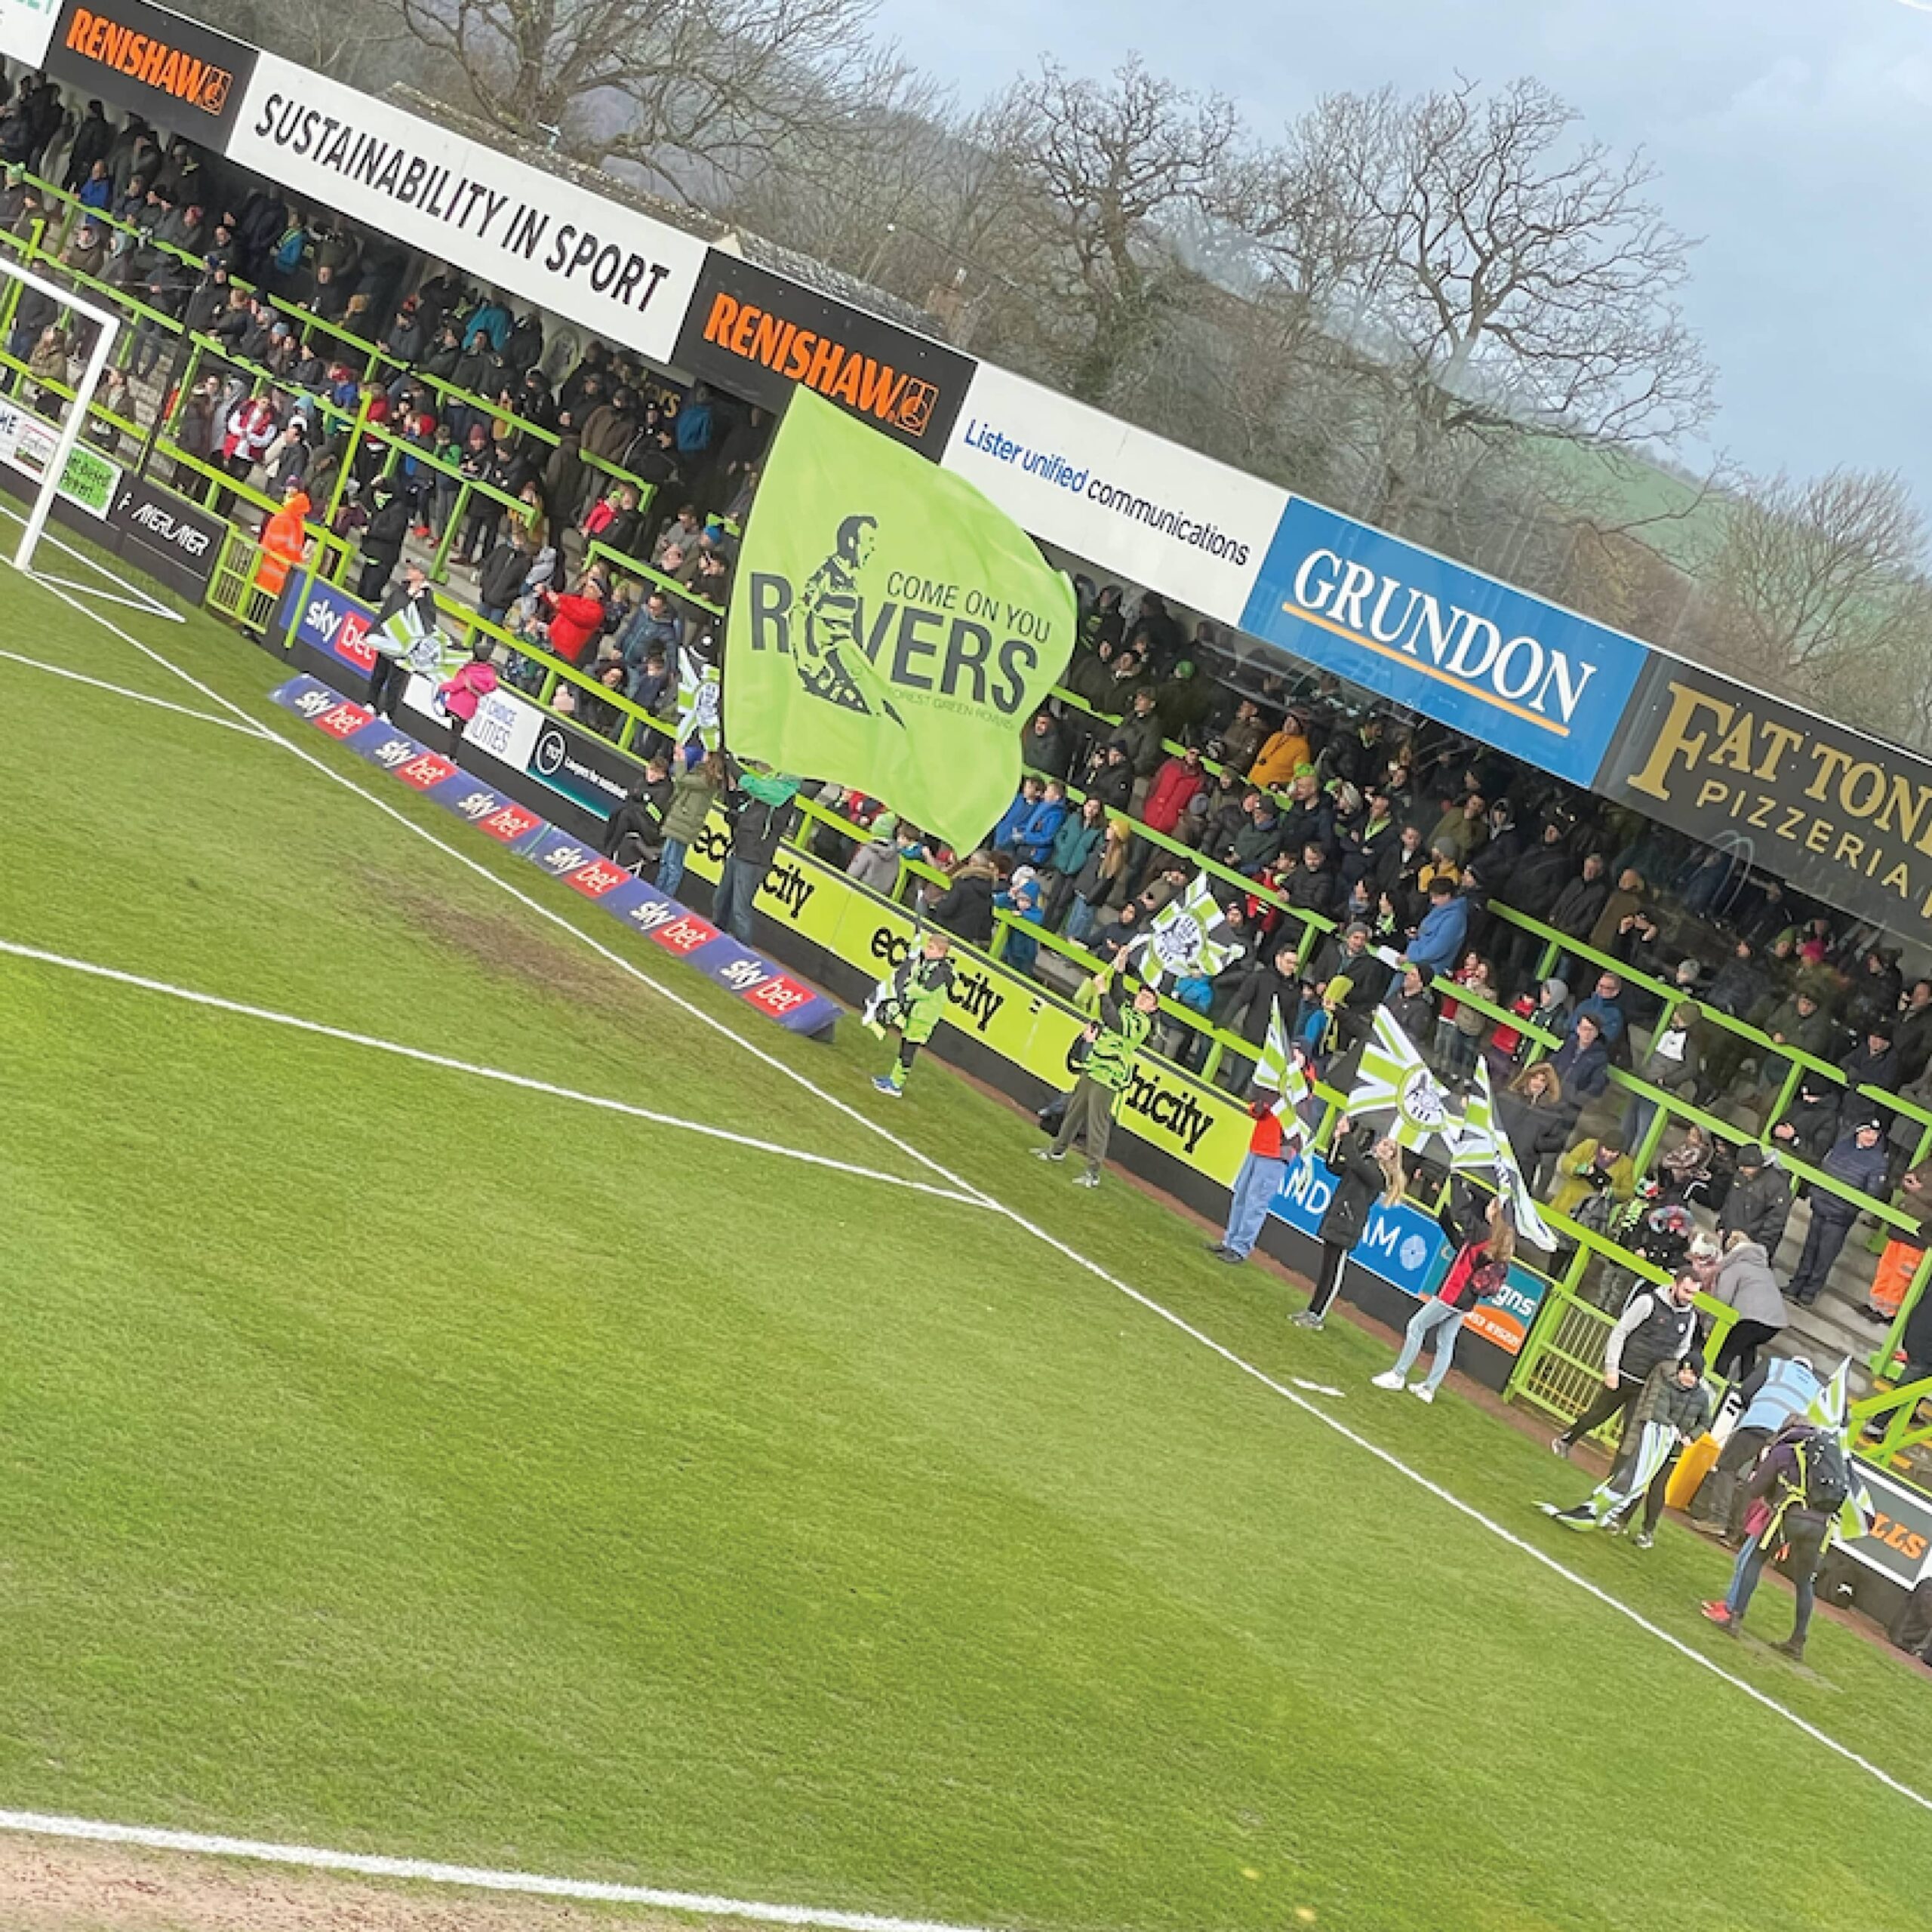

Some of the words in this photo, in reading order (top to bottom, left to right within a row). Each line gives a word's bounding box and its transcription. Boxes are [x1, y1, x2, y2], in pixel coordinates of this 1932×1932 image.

[66, 8, 211, 103] RENISHAW
[255, 93, 509, 238] SUSTAINABILITY
[500, 203, 551, 260] IN
[546, 224, 671, 312] SPORT
[703, 292, 907, 419] RENISHAW
[964, 419, 1023, 463] Lister
[1022, 447, 1090, 494] unified
[1087, 478, 1251, 567] communications
[305, 599, 342, 642] sky
[887, 571, 959, 609] COME
[965, 589, 1001, 623] ON
[1004, 602, 1052, 644] YOU
[1294, 548, 1597, 724] GRUNDON
[295, 691, 337, 718] sky
[374, 740, 417, 768] sky
[1627, 681, 1804, 801] FAT
[458, 792, 502, 820] sky
[1695, 778, 1909, 898] PIZZERIA
[544, 845, 589, 875] sky
[574, 862, 620, 894] bet
[629, 900, 677, 931] sky
[663, 918, 709, 949] bet
[720, 959, 771, 991] sky
[756, 978, 805, 1011] bet
[1870, 1511, 1929, 1560] LLS
